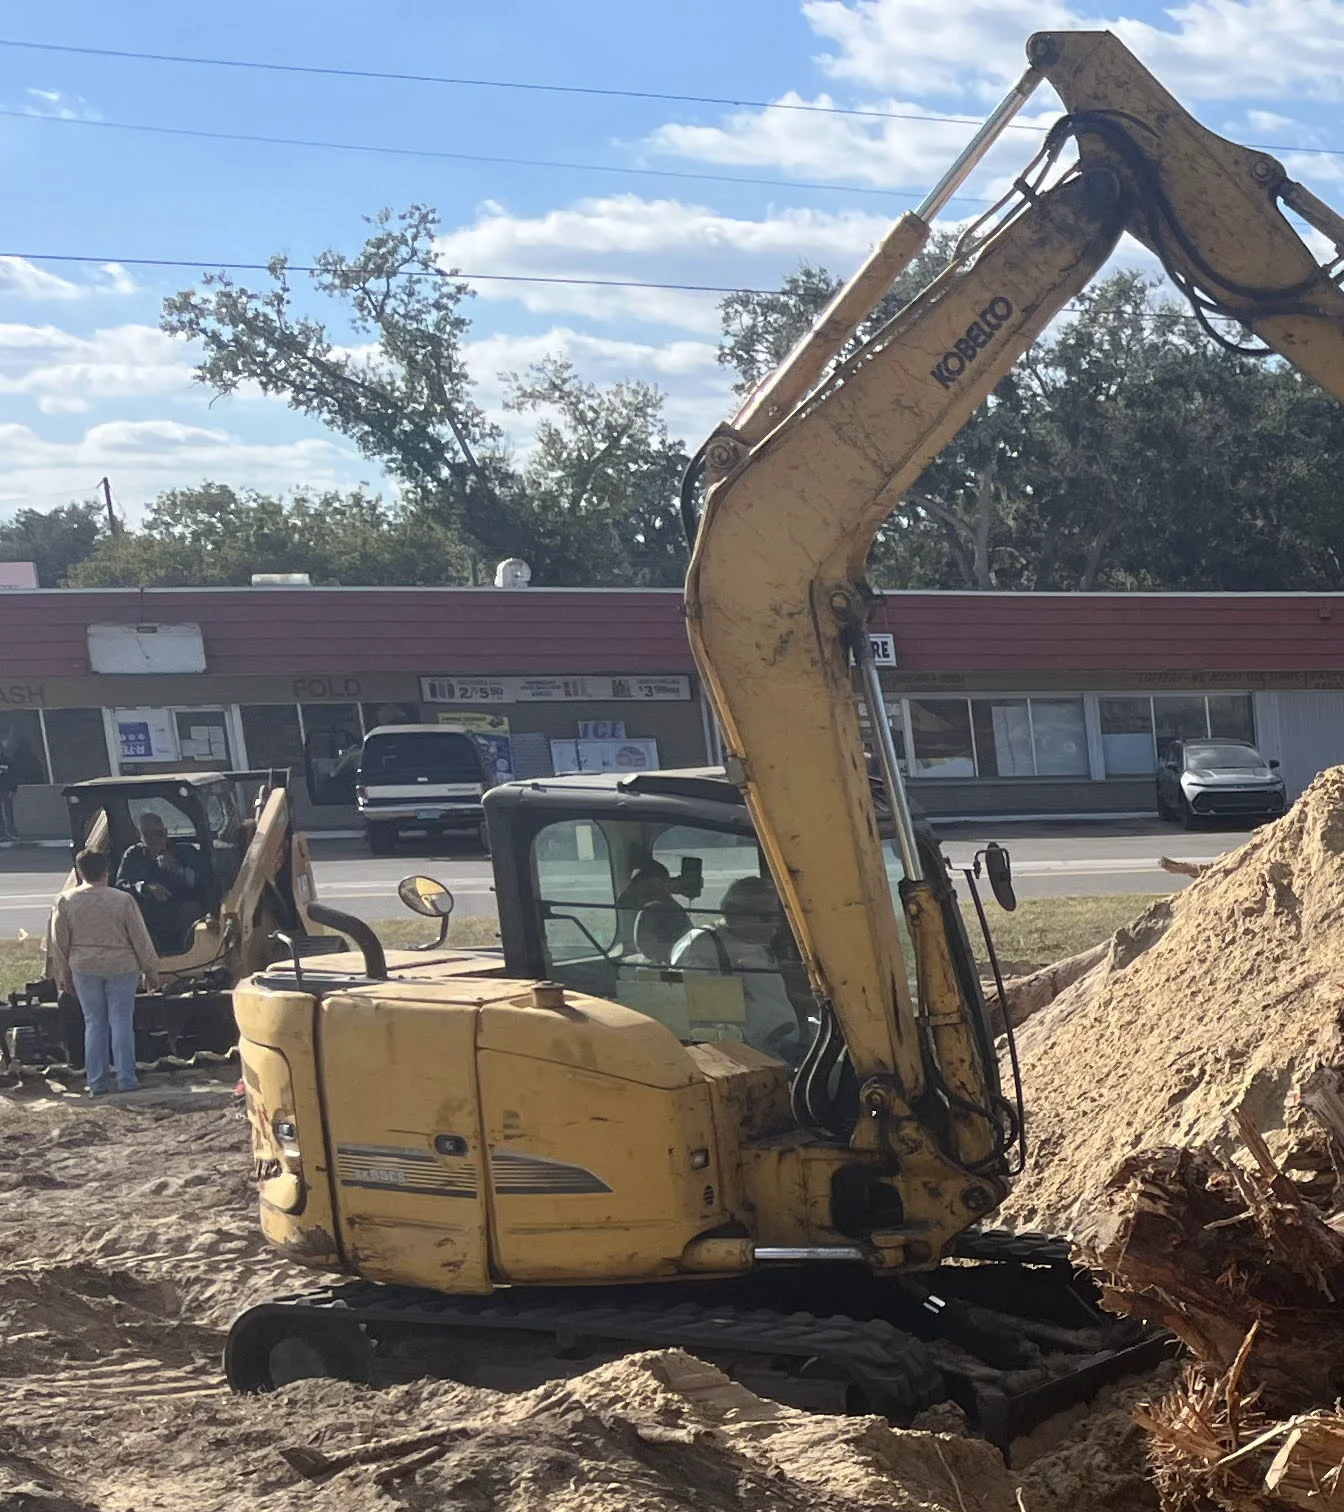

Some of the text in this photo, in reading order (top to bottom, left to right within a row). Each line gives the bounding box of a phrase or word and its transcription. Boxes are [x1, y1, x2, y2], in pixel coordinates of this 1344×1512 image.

[930, 296, 1013, 389] KOBELCO
[293, 679, 361, 698] FOLD
[582, 722, 625, 739] ICE
